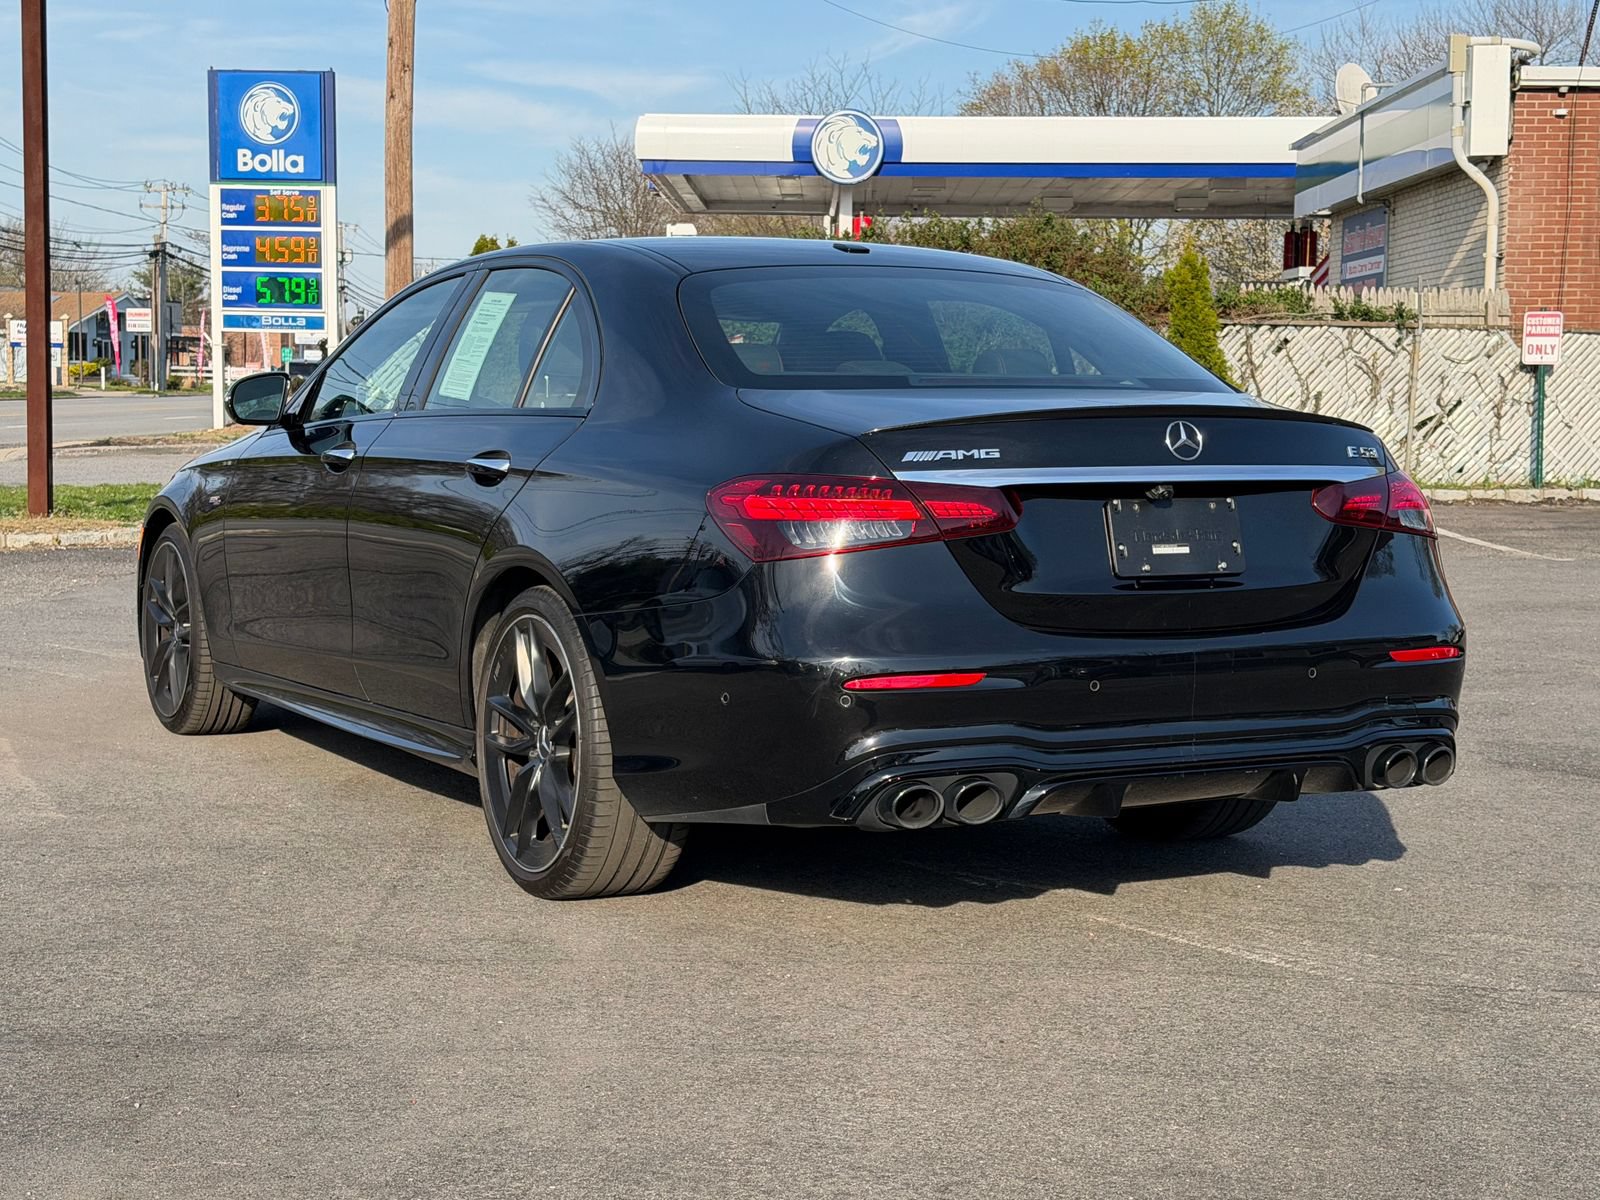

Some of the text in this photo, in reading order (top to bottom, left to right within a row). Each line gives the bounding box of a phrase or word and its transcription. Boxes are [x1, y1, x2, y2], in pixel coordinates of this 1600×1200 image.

[237, 149, 304, 173] Bolla
[221, 203, 246, 212] Regular
[256, 195, 304, 222] 3.75
[222, 211, 238, 219] Cash
[222, 244, 250, 253] Supreme
[256, 236, 304, 263] 4.59
[223, 286, 242, 294] Diesel
[256, 276, 306, 304] 5.79
[1526, 325, 1560, 335] PARKING
[1527, 343, 1557, 355] ONLY
